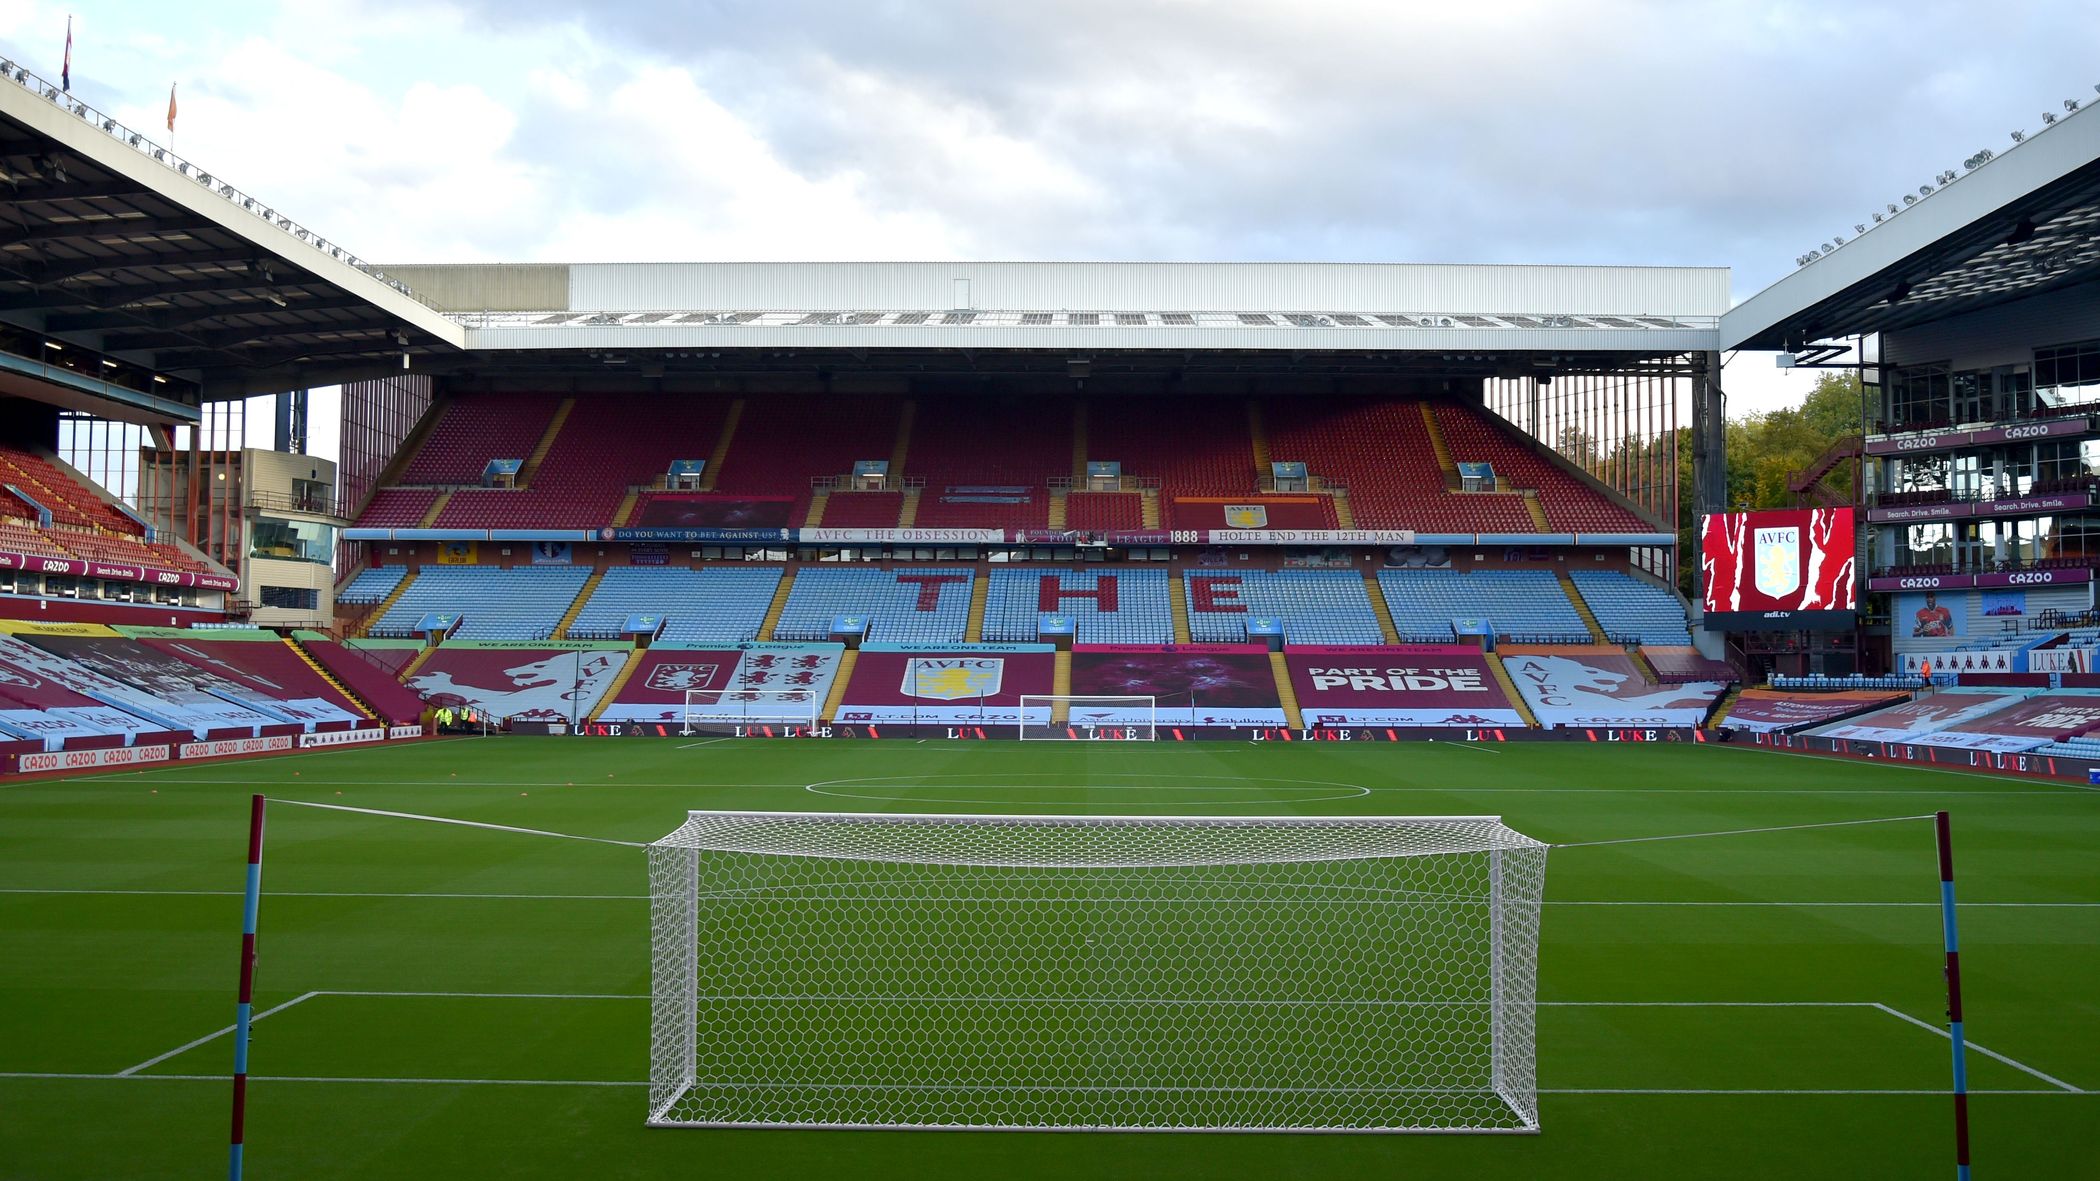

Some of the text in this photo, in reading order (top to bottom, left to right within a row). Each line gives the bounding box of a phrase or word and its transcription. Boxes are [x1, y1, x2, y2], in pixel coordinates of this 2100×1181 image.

[2005, 426, 2049, 439] CAZOO
[1897, 437, 1936, 450] CAZOO
[1994, 504, 2019, 512] Search.
[2042, 499, 2065, 508] Smile.
[719, 531, 759, 539] AGAINST
[813, 530, 991, 541] AVFC THE OBSESSION
[1116, 536, 1164, 544] LEAGUE
[1170, 530, 1198, 543] 1888
[1218, 532, 1406, 541] HOLTE END THE 12TH MAN
[1759, 531, 1796, 544] AVFC
[43, 560, 70, 573] CAZOO
[158, 572, 180, 584] CAZOO
[1900, 577, 1940, 588] CAZOO
[2008, 572, 2052, 584] CAZOO
[896, 575, 1248, 613] THE
[660, 664, 714, 672] AVFC
[917, 660, 996, 669] AVFC
[2033, 653, 2065, 672] LUKE
[1308, 668, 1482, 676] PART OF THE
[1312, 675, 1489, 691] PRIDE
[574, 724, 622, 736] LUKE
[1090, 728, 1137, 741] LUKE
[1302, 729, 1351, 741] LUKE
[1607, 730, 1658, 741] LUKE
[185, 744, 209, 757] CAZOO
[214, 742, 237, 755] CAZOO
[242, 740, 264, 752] CAZOO
[269, 738, 289, 750] CAZOO
[66, 752, 97, 767] CAZOO
[104, 749, 133, 763] CAZOO
[139, 747, 166, 760] CAZOO
[24, 755, 58, 770] CAZOO
[1997, 754, 2027, 772] LUKE
